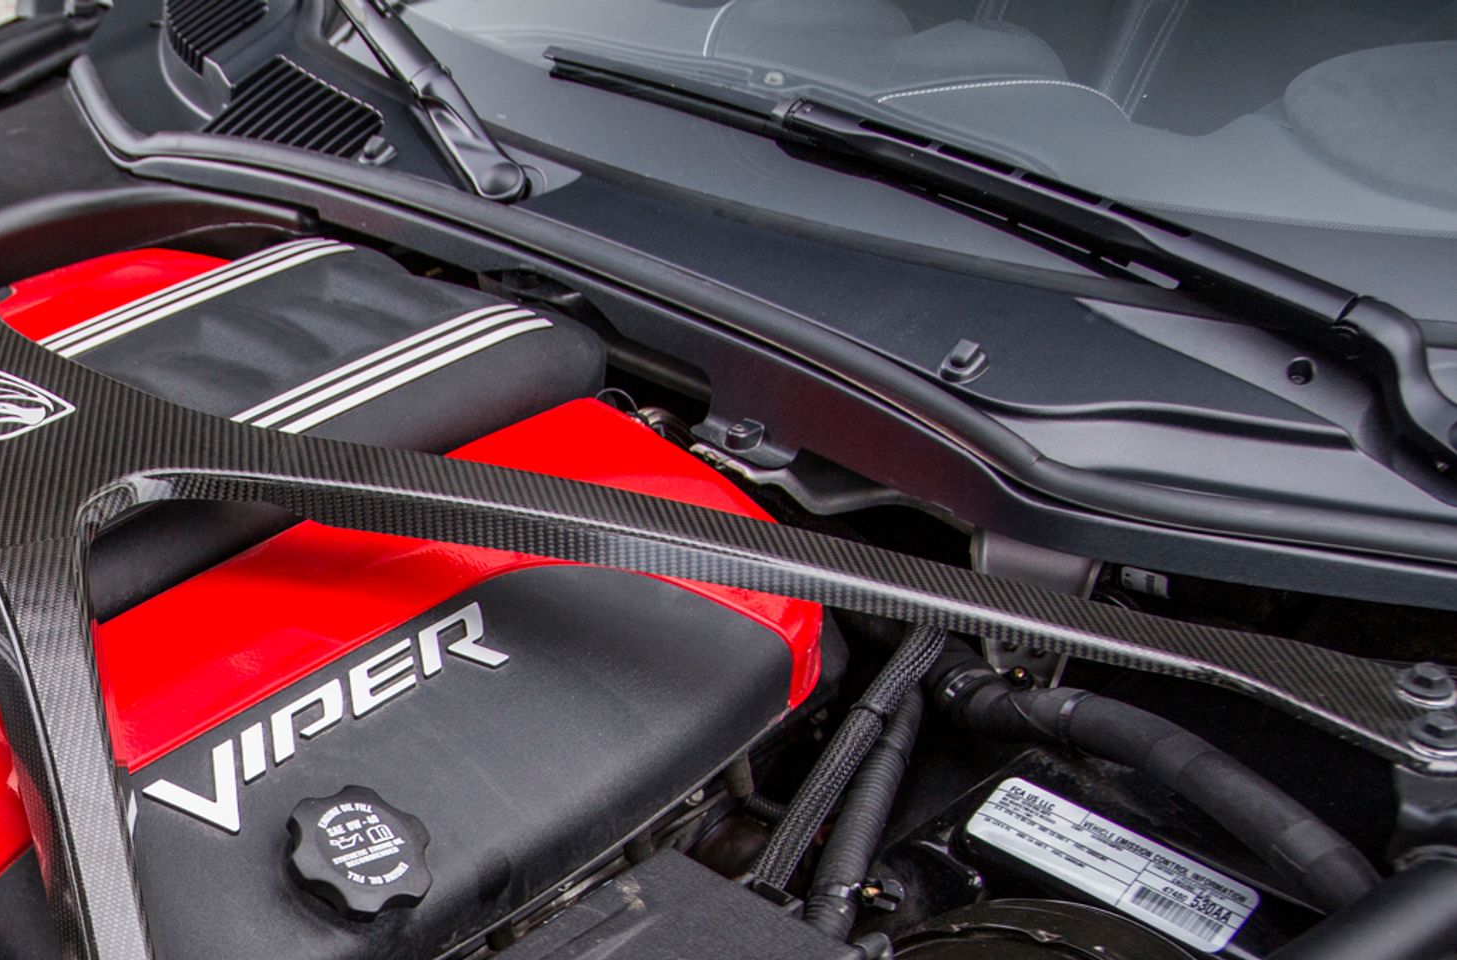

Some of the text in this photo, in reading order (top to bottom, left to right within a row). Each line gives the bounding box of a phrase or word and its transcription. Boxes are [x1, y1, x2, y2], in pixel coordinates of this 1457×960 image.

[142, 601, 510, 834] VIPER
[1009, 785, 1027, 797] FCA
[1026, 793, 1041, 802] US
[1038, 799, 1056, 811] LLC
[317, 803, 373, 829] ENGINE OIL FILL
[326, 824, 346, 837] SAE
[1083, 820, 1115, 840] VEHICLE
[1115, 833, 1154, 858] EMISSION
[1153, 854, 1189, 875] CONTROL
[1190, 872, 1248, 903] INFORMATION
[347, 870, 365, 883] FILL
[1189, 895, 1232, 922] 530AA
